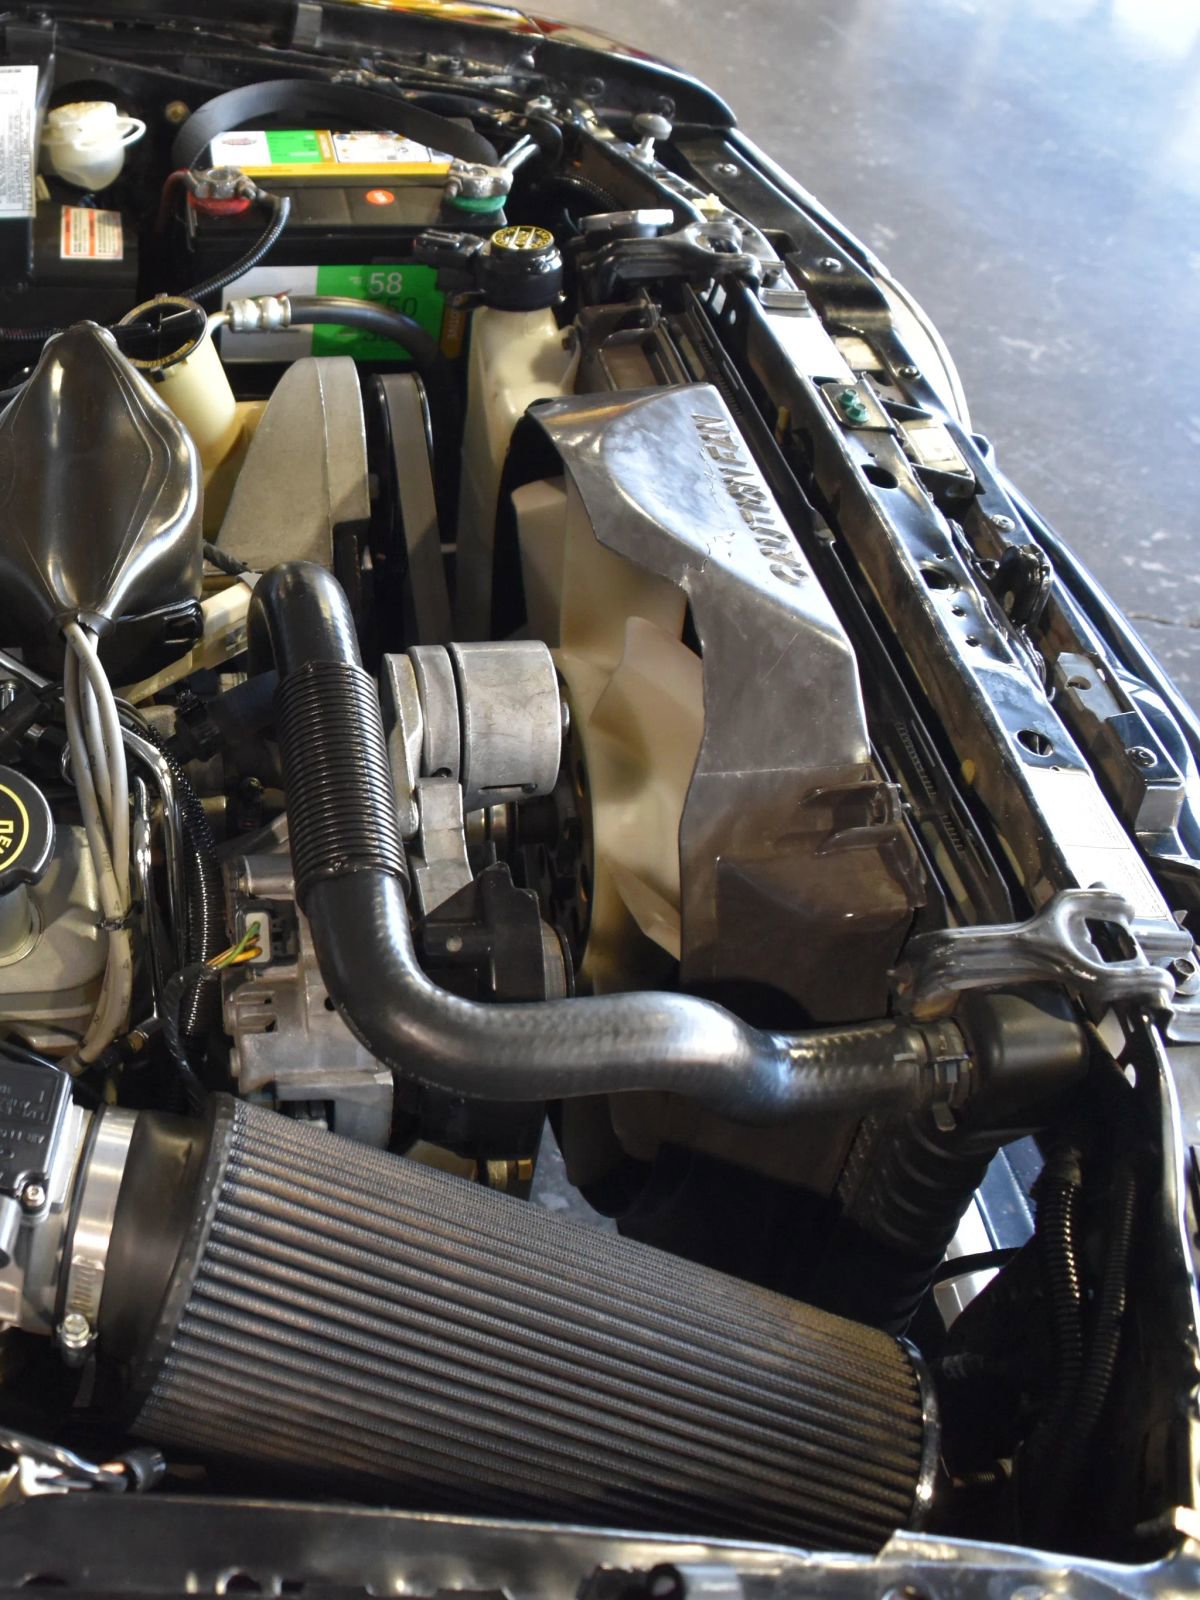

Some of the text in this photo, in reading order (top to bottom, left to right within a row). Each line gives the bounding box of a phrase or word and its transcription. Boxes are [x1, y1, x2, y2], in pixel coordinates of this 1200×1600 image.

[369, 272, 402, 295] 58
[691, 414, 809, 587] CAUTION FAN
